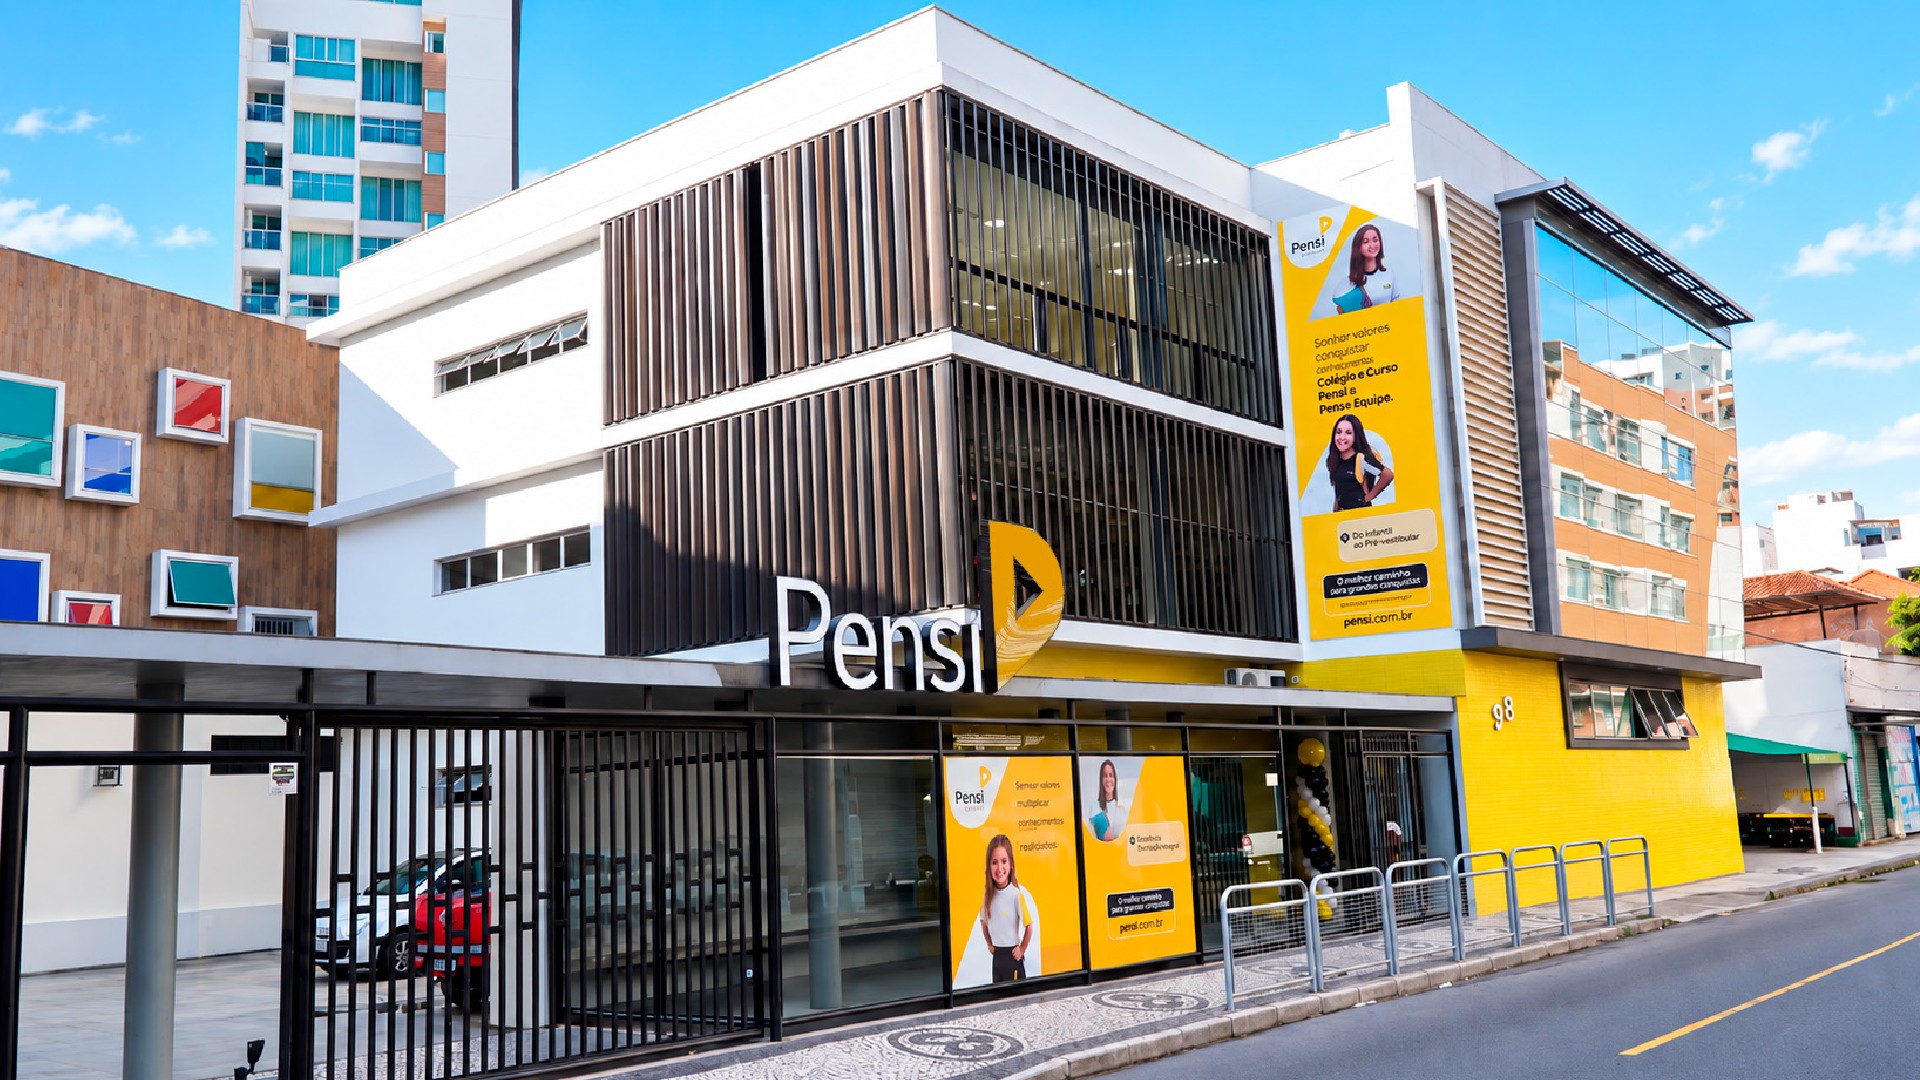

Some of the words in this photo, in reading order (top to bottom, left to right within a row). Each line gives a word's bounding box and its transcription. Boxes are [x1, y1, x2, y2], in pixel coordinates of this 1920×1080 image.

[1352, 324, 1391, 339] valores
[1357, 371, 1365, 379] e
[1365, 364, 1398, 377] Curso
[1319, 402, 1351, 414] Pense
[1354, 393, 1394, 408] Equipe.
[1344, 609, 1413, 629] pensi.com.br
[770, 575, 984, 693] Pensi
[1491, 695, 1515, 731] 98
[955, 789, 985, 805] Pensi
